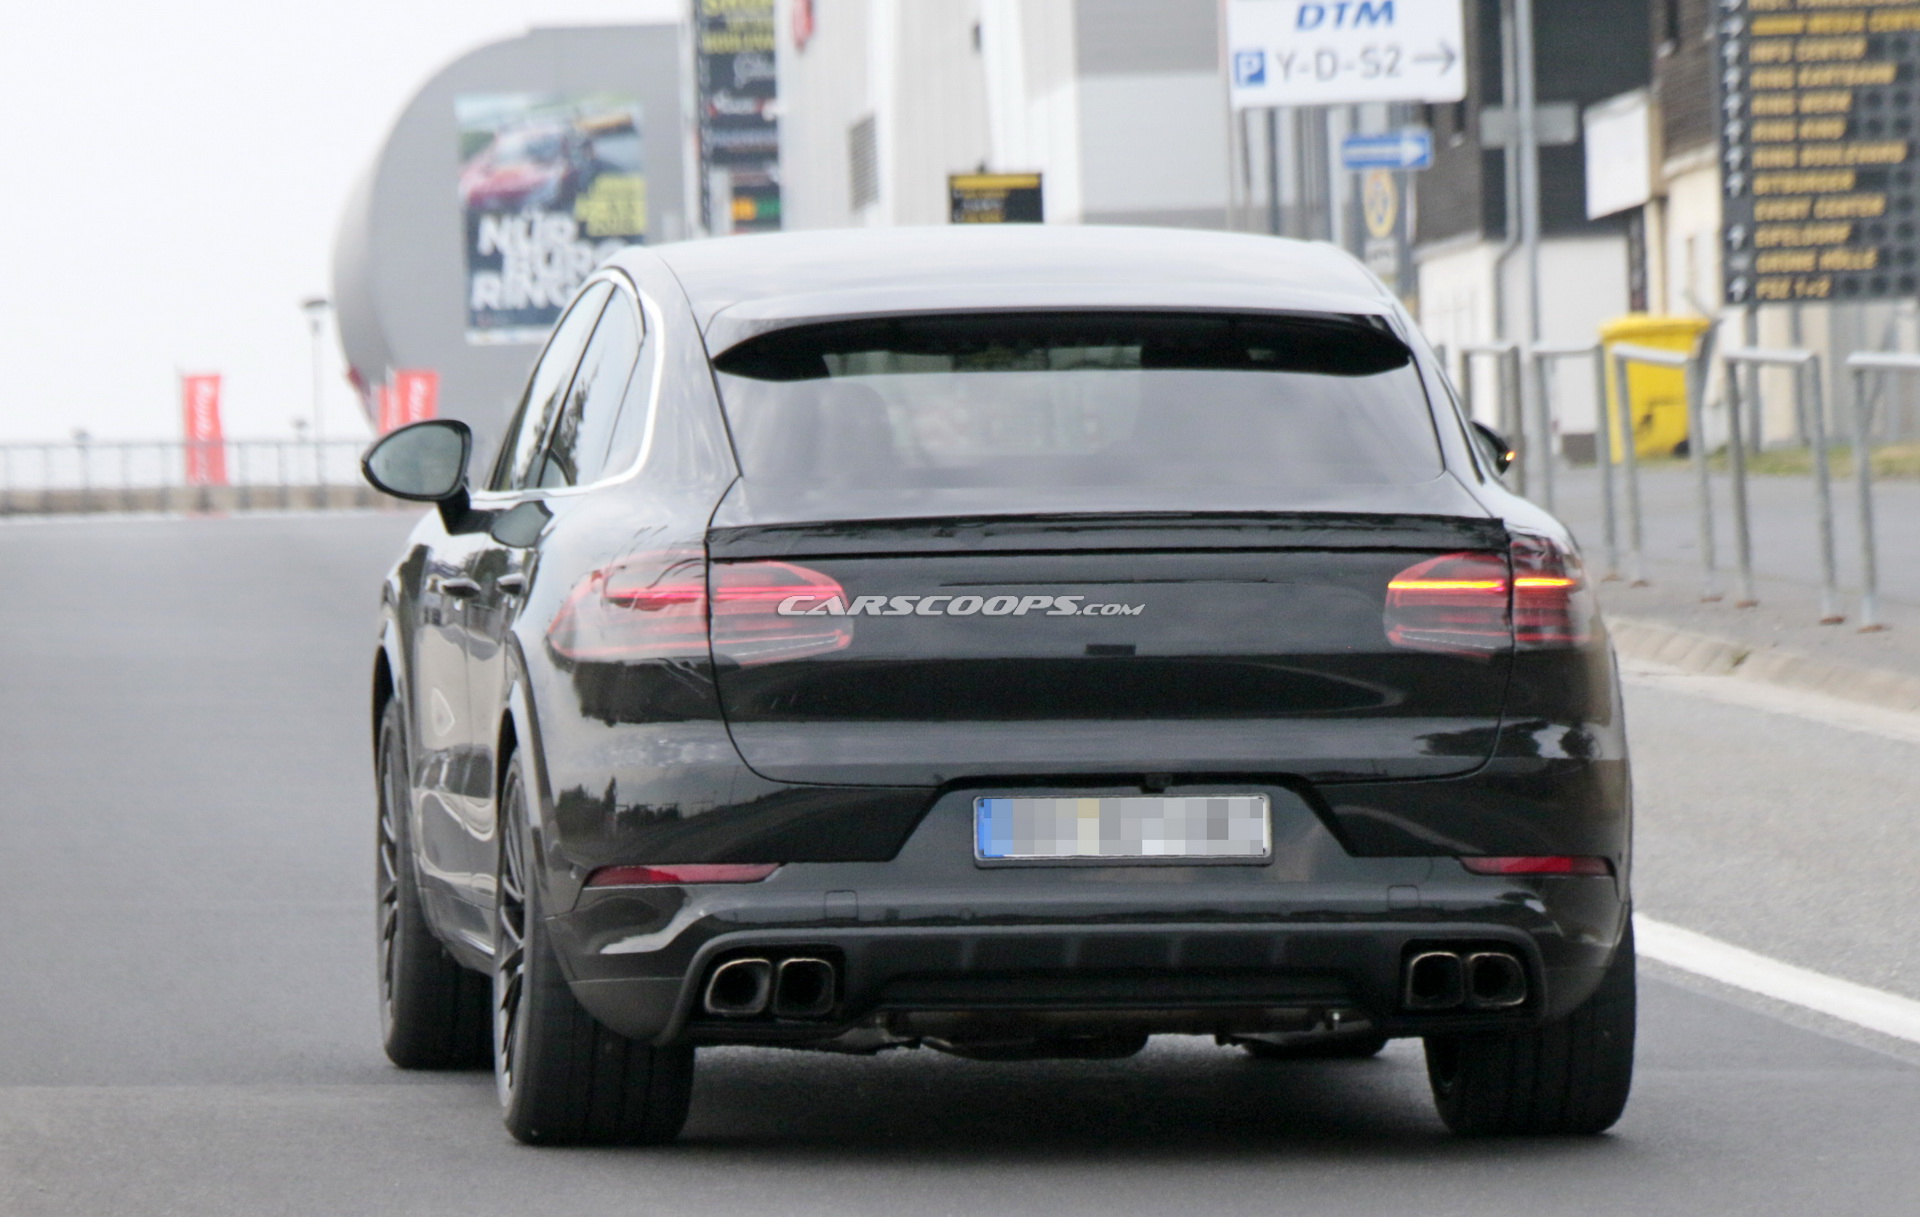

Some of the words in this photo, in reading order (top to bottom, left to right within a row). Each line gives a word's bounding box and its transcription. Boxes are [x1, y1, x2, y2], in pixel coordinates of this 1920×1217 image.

[1296, 1, 1394, 30] DTM
[1276, 46, 1402, 80] Y-D-S2
[477, 205, 578, 256] NÜR
